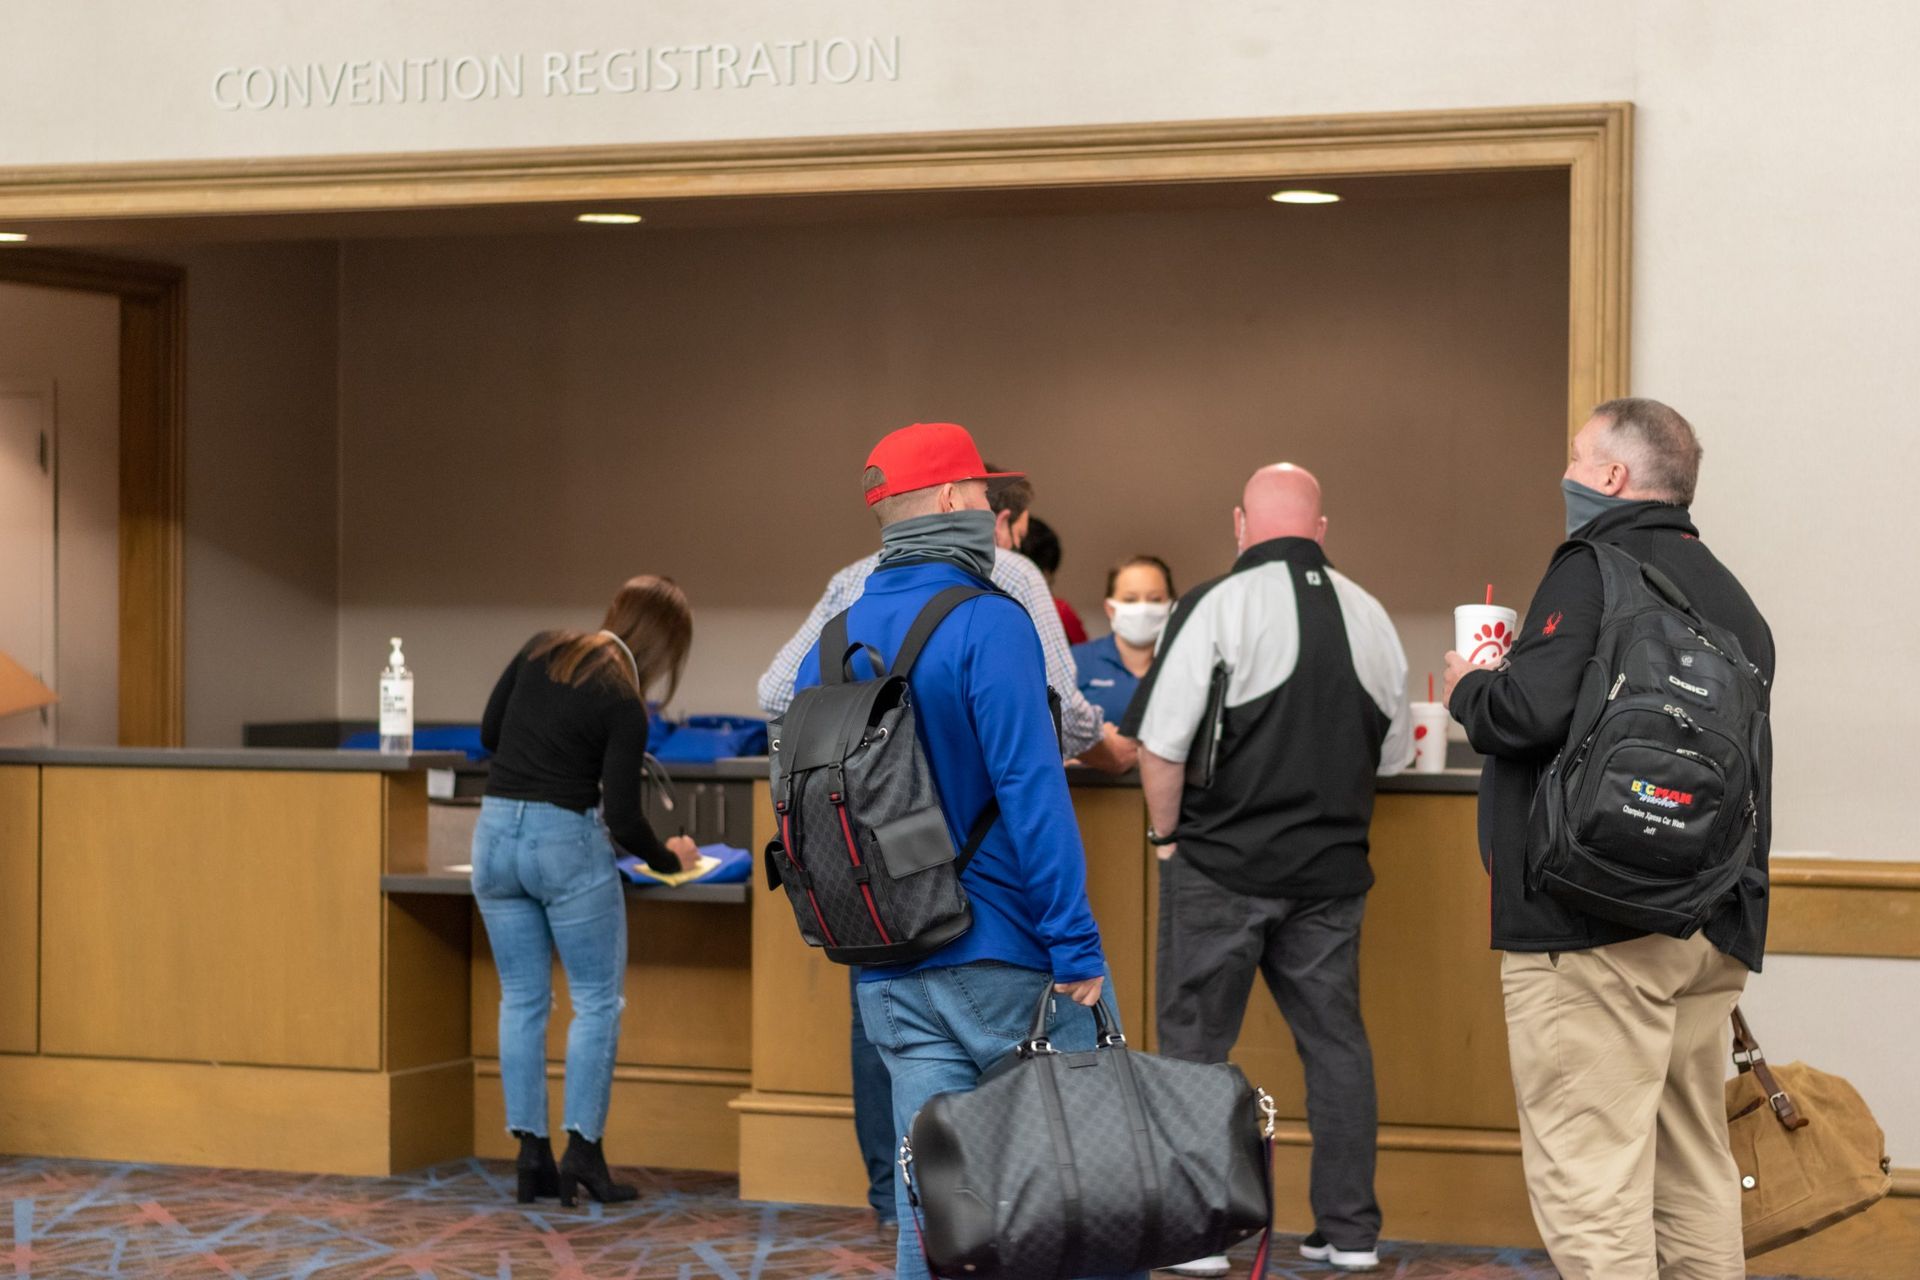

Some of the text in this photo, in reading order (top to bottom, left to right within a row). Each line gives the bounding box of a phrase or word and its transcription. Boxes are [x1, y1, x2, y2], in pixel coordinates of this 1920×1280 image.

[212, 35, 901, 112] CONVENTION REGISTRATION
[1622, 804, 1645, 818] Champion
[1662, 816, 1671, 825] Car
[1672, 819, 1685, 829] Wash
[1643, 826, 1656, 836] Jeff
